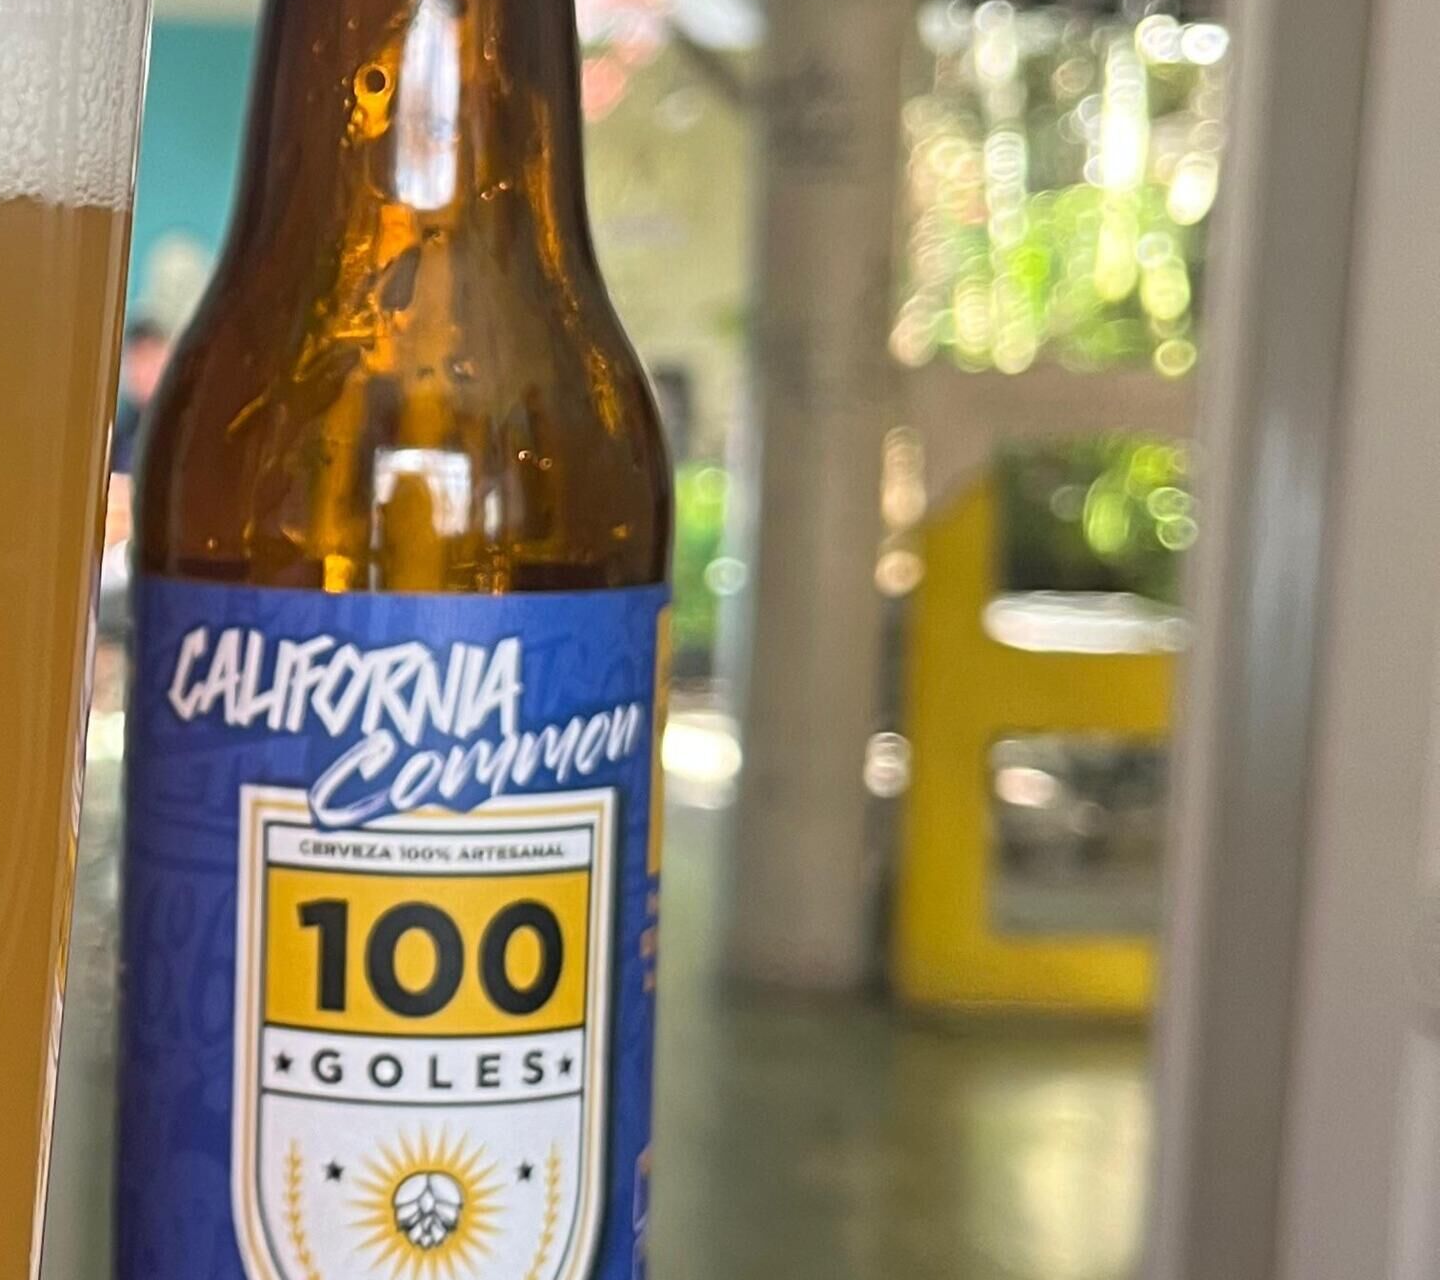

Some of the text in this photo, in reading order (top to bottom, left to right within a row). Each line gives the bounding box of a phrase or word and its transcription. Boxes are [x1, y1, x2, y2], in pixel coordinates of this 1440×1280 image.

[169, 628, 523, 745] CALIFORNIA
[308, 702, 643, 822] Common
[298, 839, 567, 862] CERVEZA 100% ARTESANAL
[296, 897, 566, 1018] 100
[311, 1049, 545, 1089] GOLES
